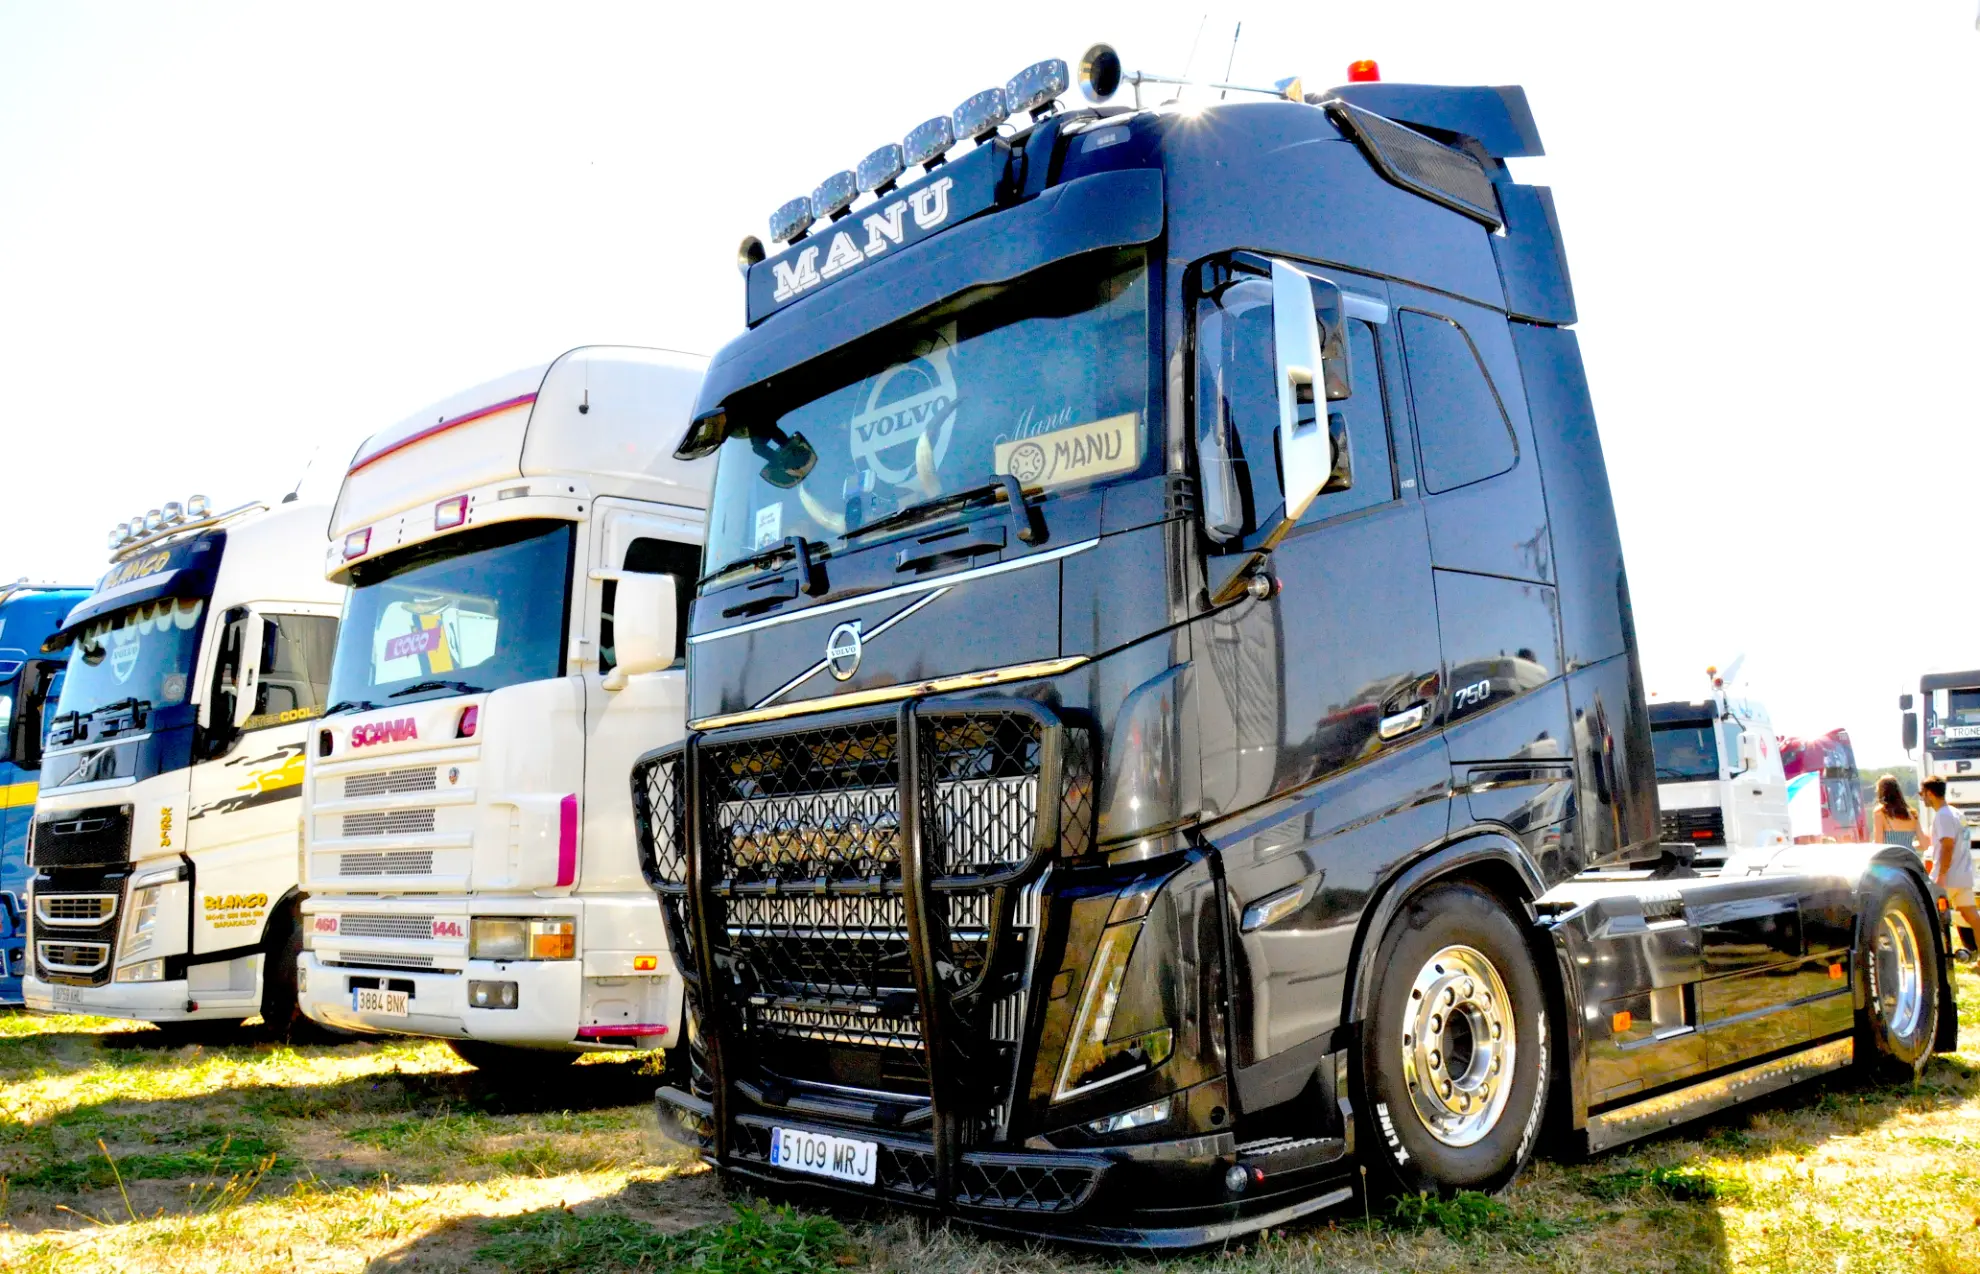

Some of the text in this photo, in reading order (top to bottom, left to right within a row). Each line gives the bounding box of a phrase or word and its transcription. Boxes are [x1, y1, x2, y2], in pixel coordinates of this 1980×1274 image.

[773, 176, 953, 302] MANU
[855, 395, 950, 443] VOLVO
[993, 405, 1072, 448] Manu
[1048, 429, 1122, 480] MANU
[104, 551, 171, 590] BLANCO
[831, 646, 856, 656] VOLVO
[1455, 680, 1490, 709] 750
[351, 717, 418, 748] SCANIA
[204, 893, 268, 911] BLANCO
[315, 918, 338, 932] 460
[360, 992, 406, 1014] 3884 BNK
[1376, 1103, 1410, 1166] X LINE
[782, 1134, 869, 1177] 5109 MRJ
